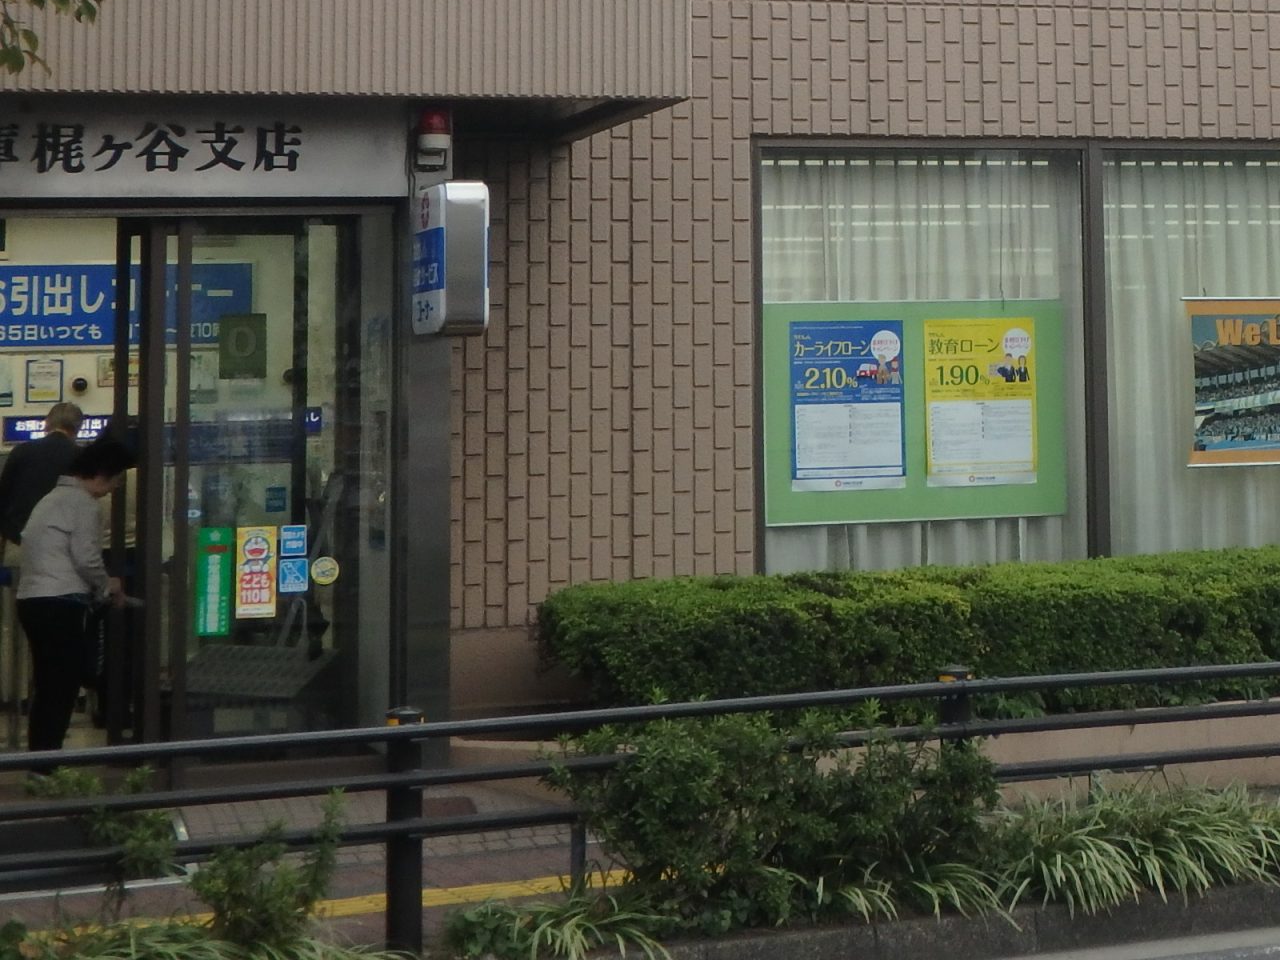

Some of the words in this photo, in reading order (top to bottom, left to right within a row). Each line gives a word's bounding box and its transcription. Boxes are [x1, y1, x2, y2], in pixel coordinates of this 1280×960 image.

[1215, 318, 1262, 347] We
[928, 337, 1000, 355] 教育ローン
